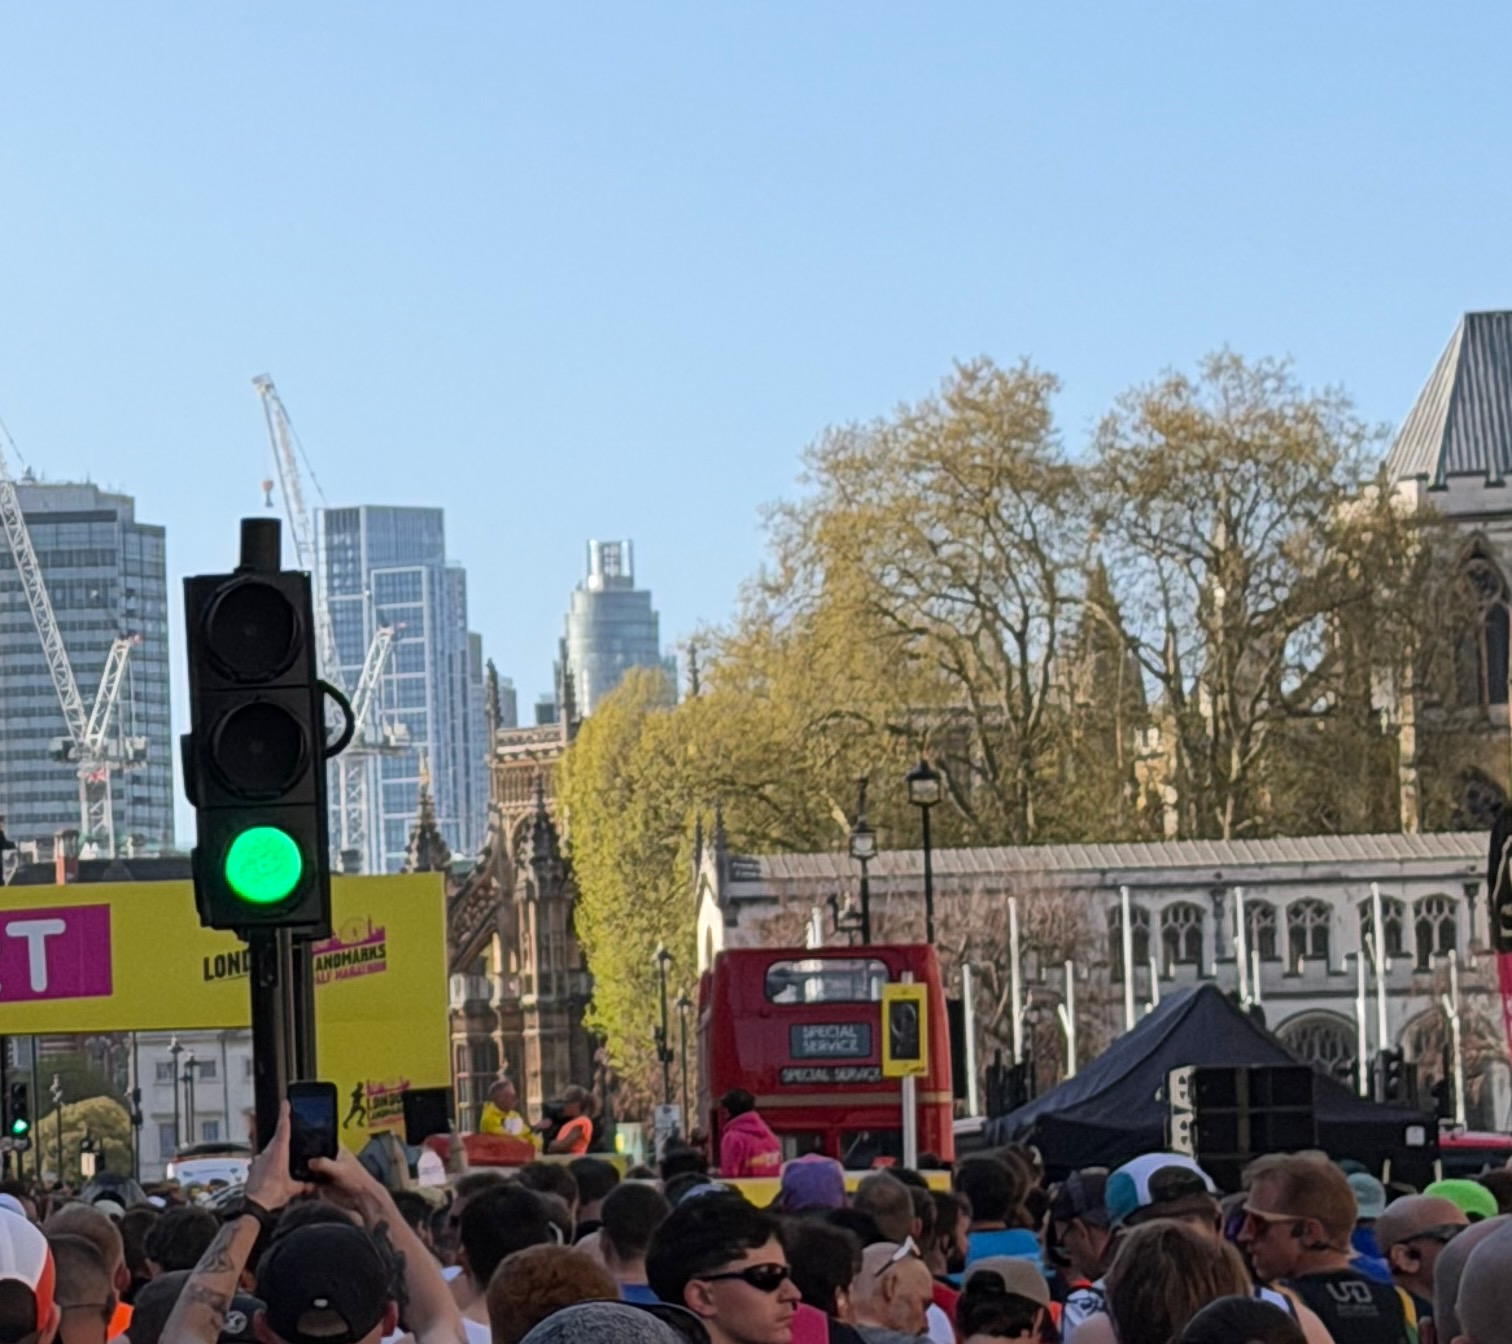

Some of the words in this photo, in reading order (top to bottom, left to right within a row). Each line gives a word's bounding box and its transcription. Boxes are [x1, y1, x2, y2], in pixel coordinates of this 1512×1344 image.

[203, 948, 252, 982] LOND
[315, 944, 386, 971] ANDMARKS
[802, 1025, 858, 1039] SPECIAL
[803, 1038, 859, 1053] SERVICE
[781, 1067, 830, 1084] SPECIAL
[834, 1067, 882, 1083] SERVICE
